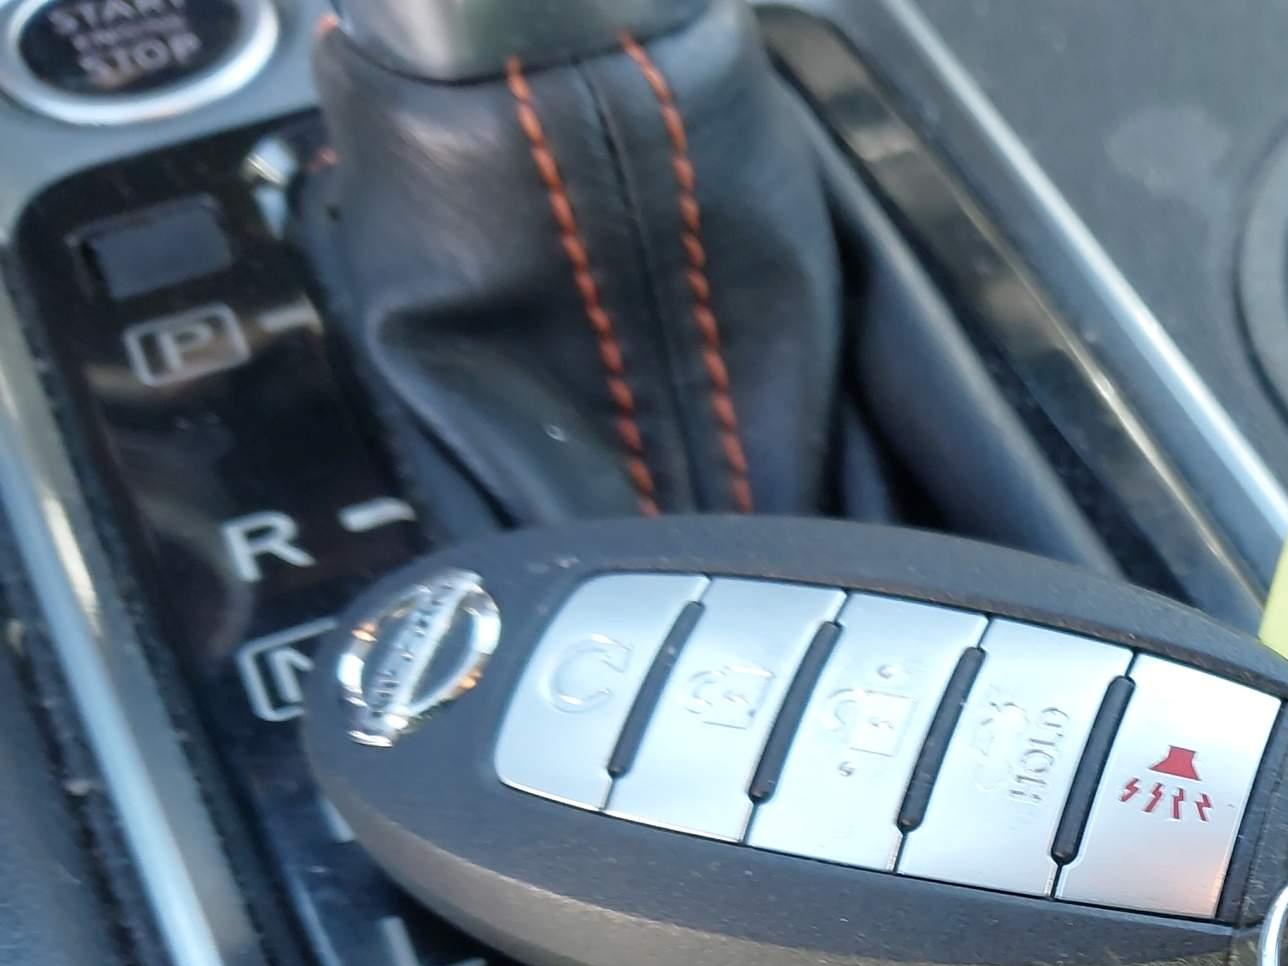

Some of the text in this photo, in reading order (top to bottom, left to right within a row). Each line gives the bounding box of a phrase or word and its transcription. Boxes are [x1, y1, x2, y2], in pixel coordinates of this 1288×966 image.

[78, 32, 202, 87] STOP
[157, 322, 214, 372] P
[222, 511, 316, 583] R
